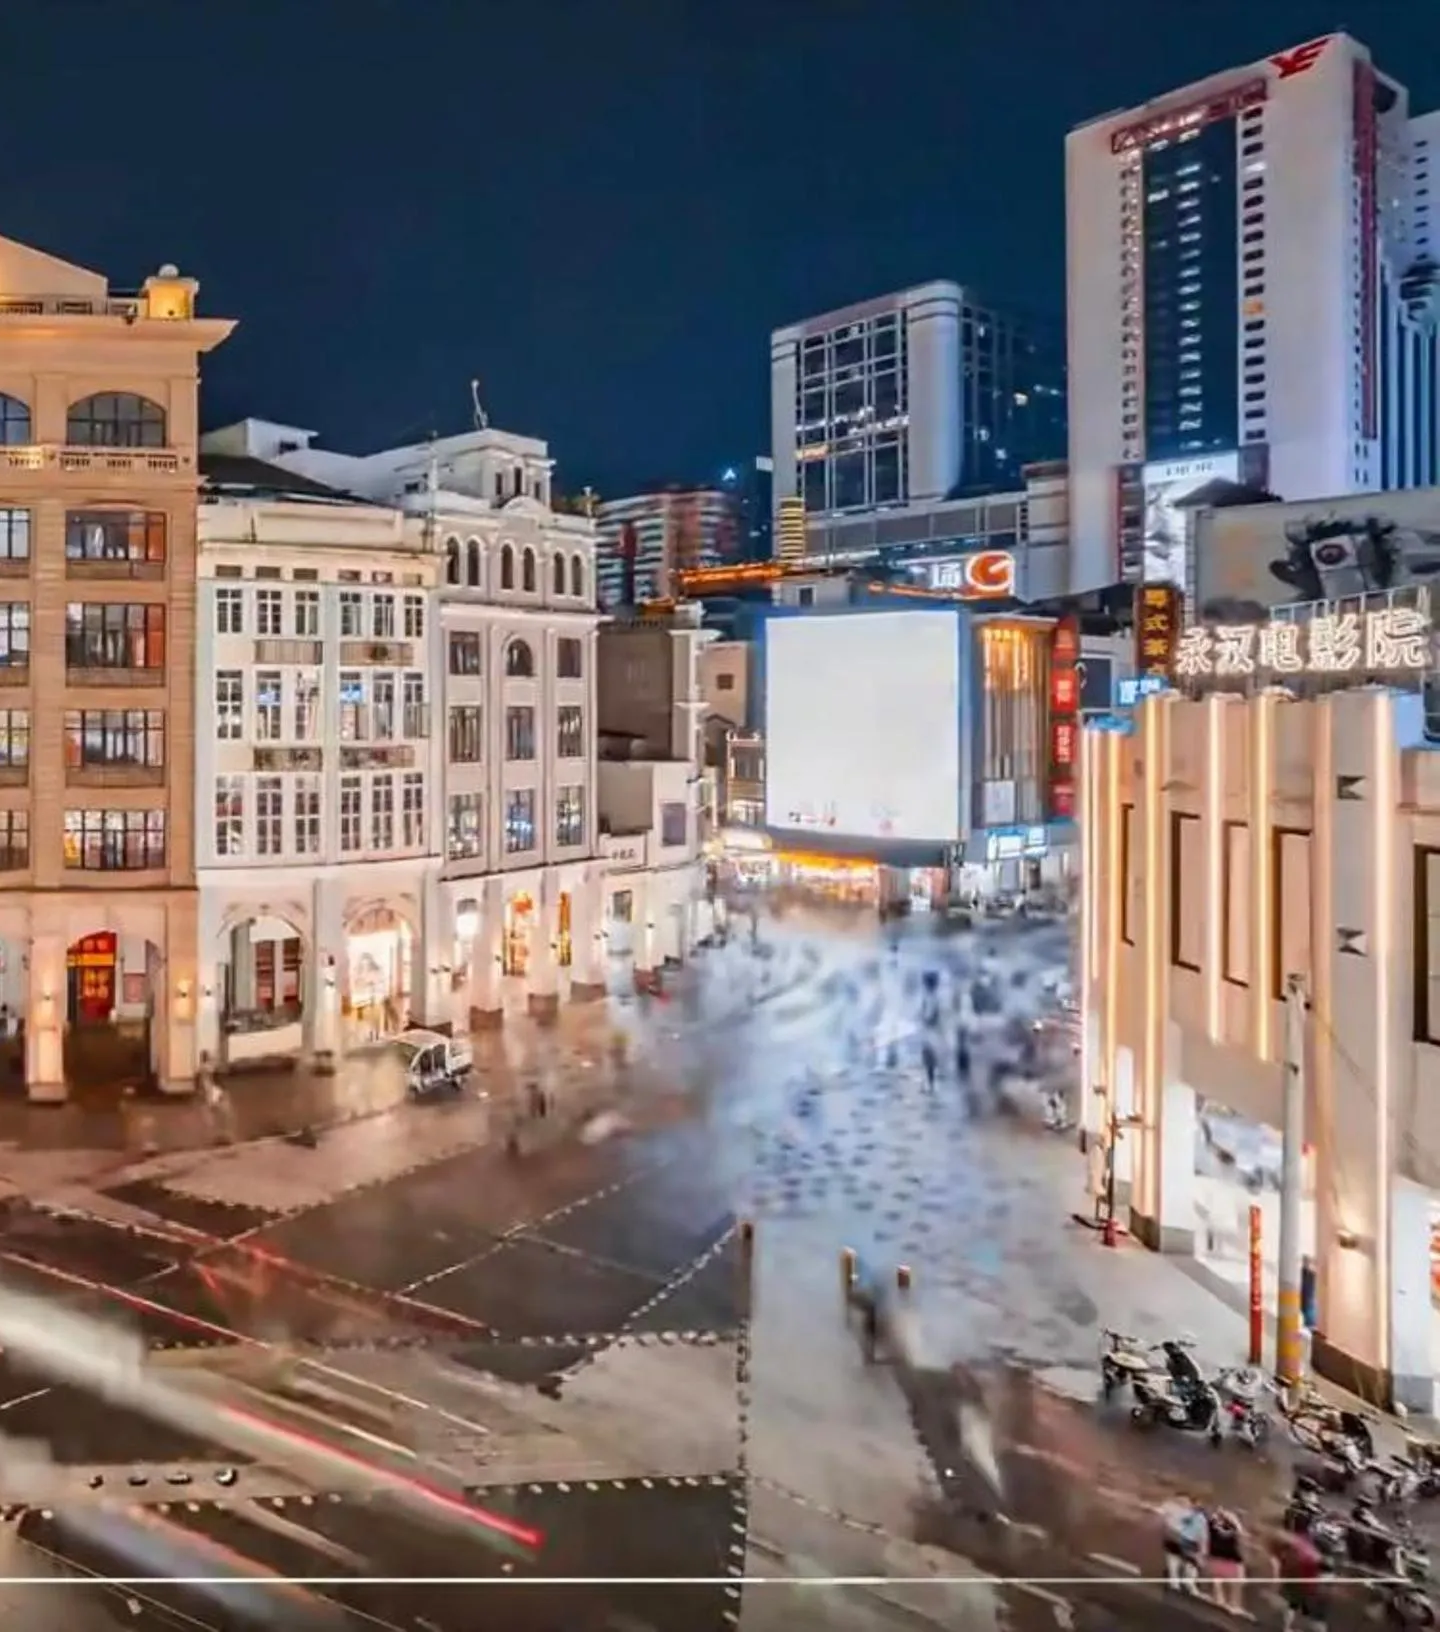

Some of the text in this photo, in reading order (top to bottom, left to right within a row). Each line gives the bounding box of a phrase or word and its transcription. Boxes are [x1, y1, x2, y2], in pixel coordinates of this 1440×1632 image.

[1176, 608, 1432, 676] 永汉电影院
